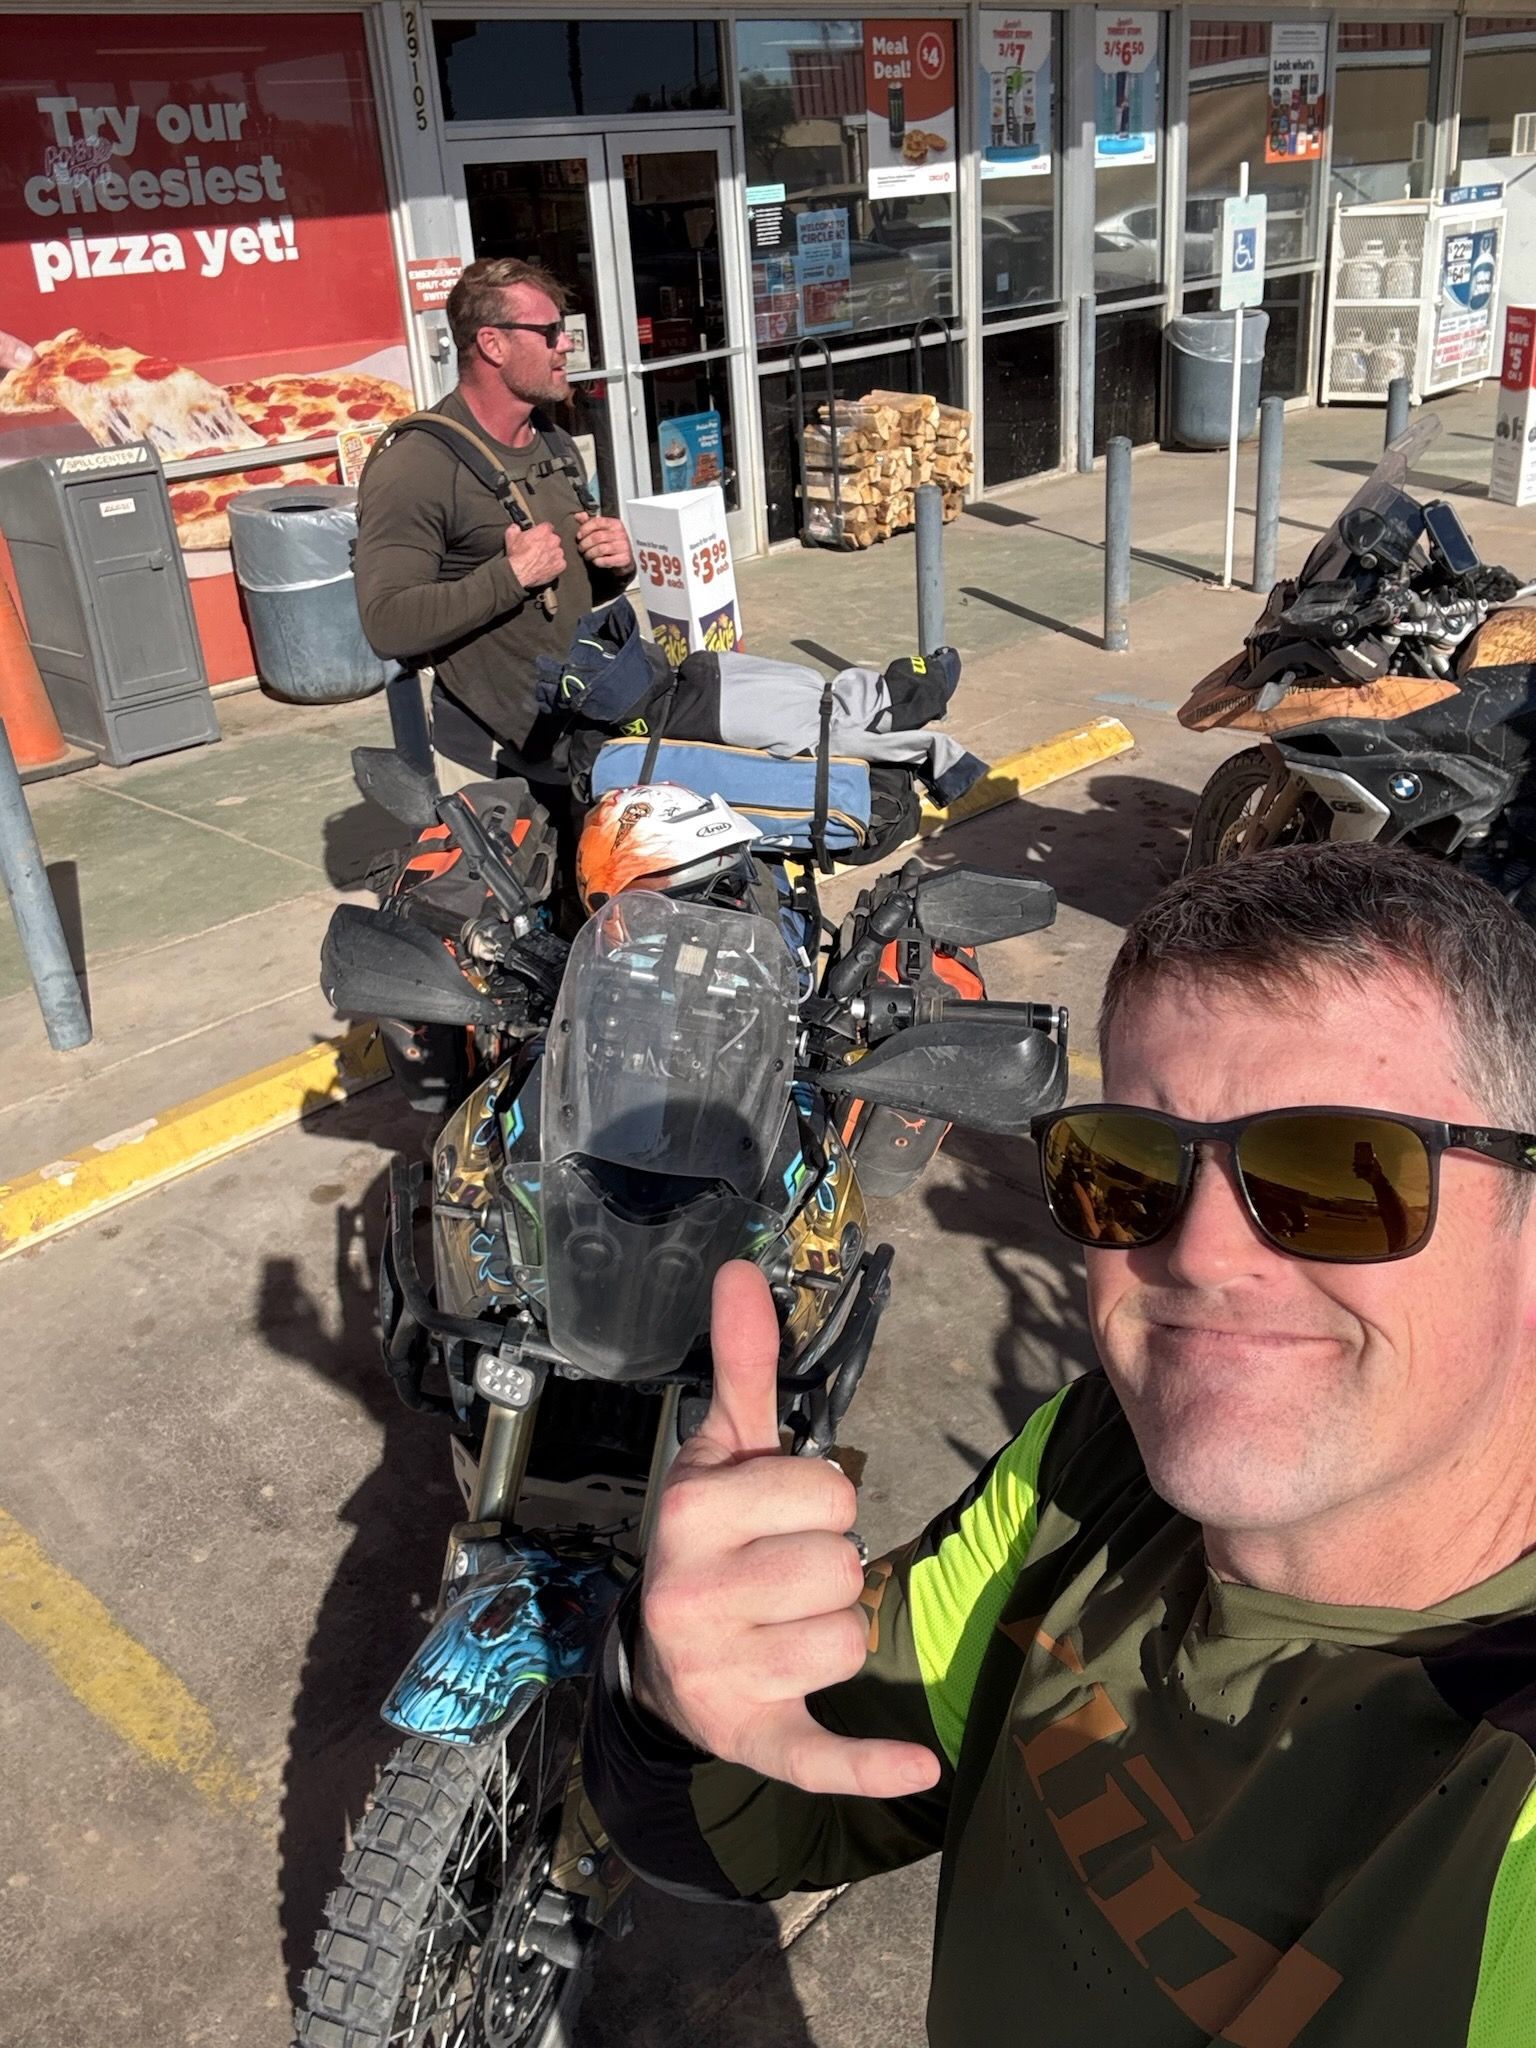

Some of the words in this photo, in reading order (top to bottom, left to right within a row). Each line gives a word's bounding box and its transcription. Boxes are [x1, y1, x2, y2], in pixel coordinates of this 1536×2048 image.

[872, 36, 909, 56] Meal
[998, 42, 1025, 66] 3/$7
[922, 46, 939, 68] $4
[405, 11, 428, 132] 29105
[873, 60, 912, 80] Deal!
[37, 96, 140, 156] Try
[156, 101, 248, 144] our
[24, 155, 287, 217] cheesiest
[800, 221, 833, 233] WELCOME
[836, 219, 846, 228] TO
[802, 231, 835, 244] CIRCLE
[30, 227, 186, 294] pizza
[193, 214, 299, 278] yet!
[408, 266, 462, 280] EMERGENCY
[66, 458, 92, 470] SPILL
[96, 451, 134, 465] CENTER
[716, 560, 730, 576] each
[667, 579, 685, 590] each
[704, 823, 727, 836] Arai
